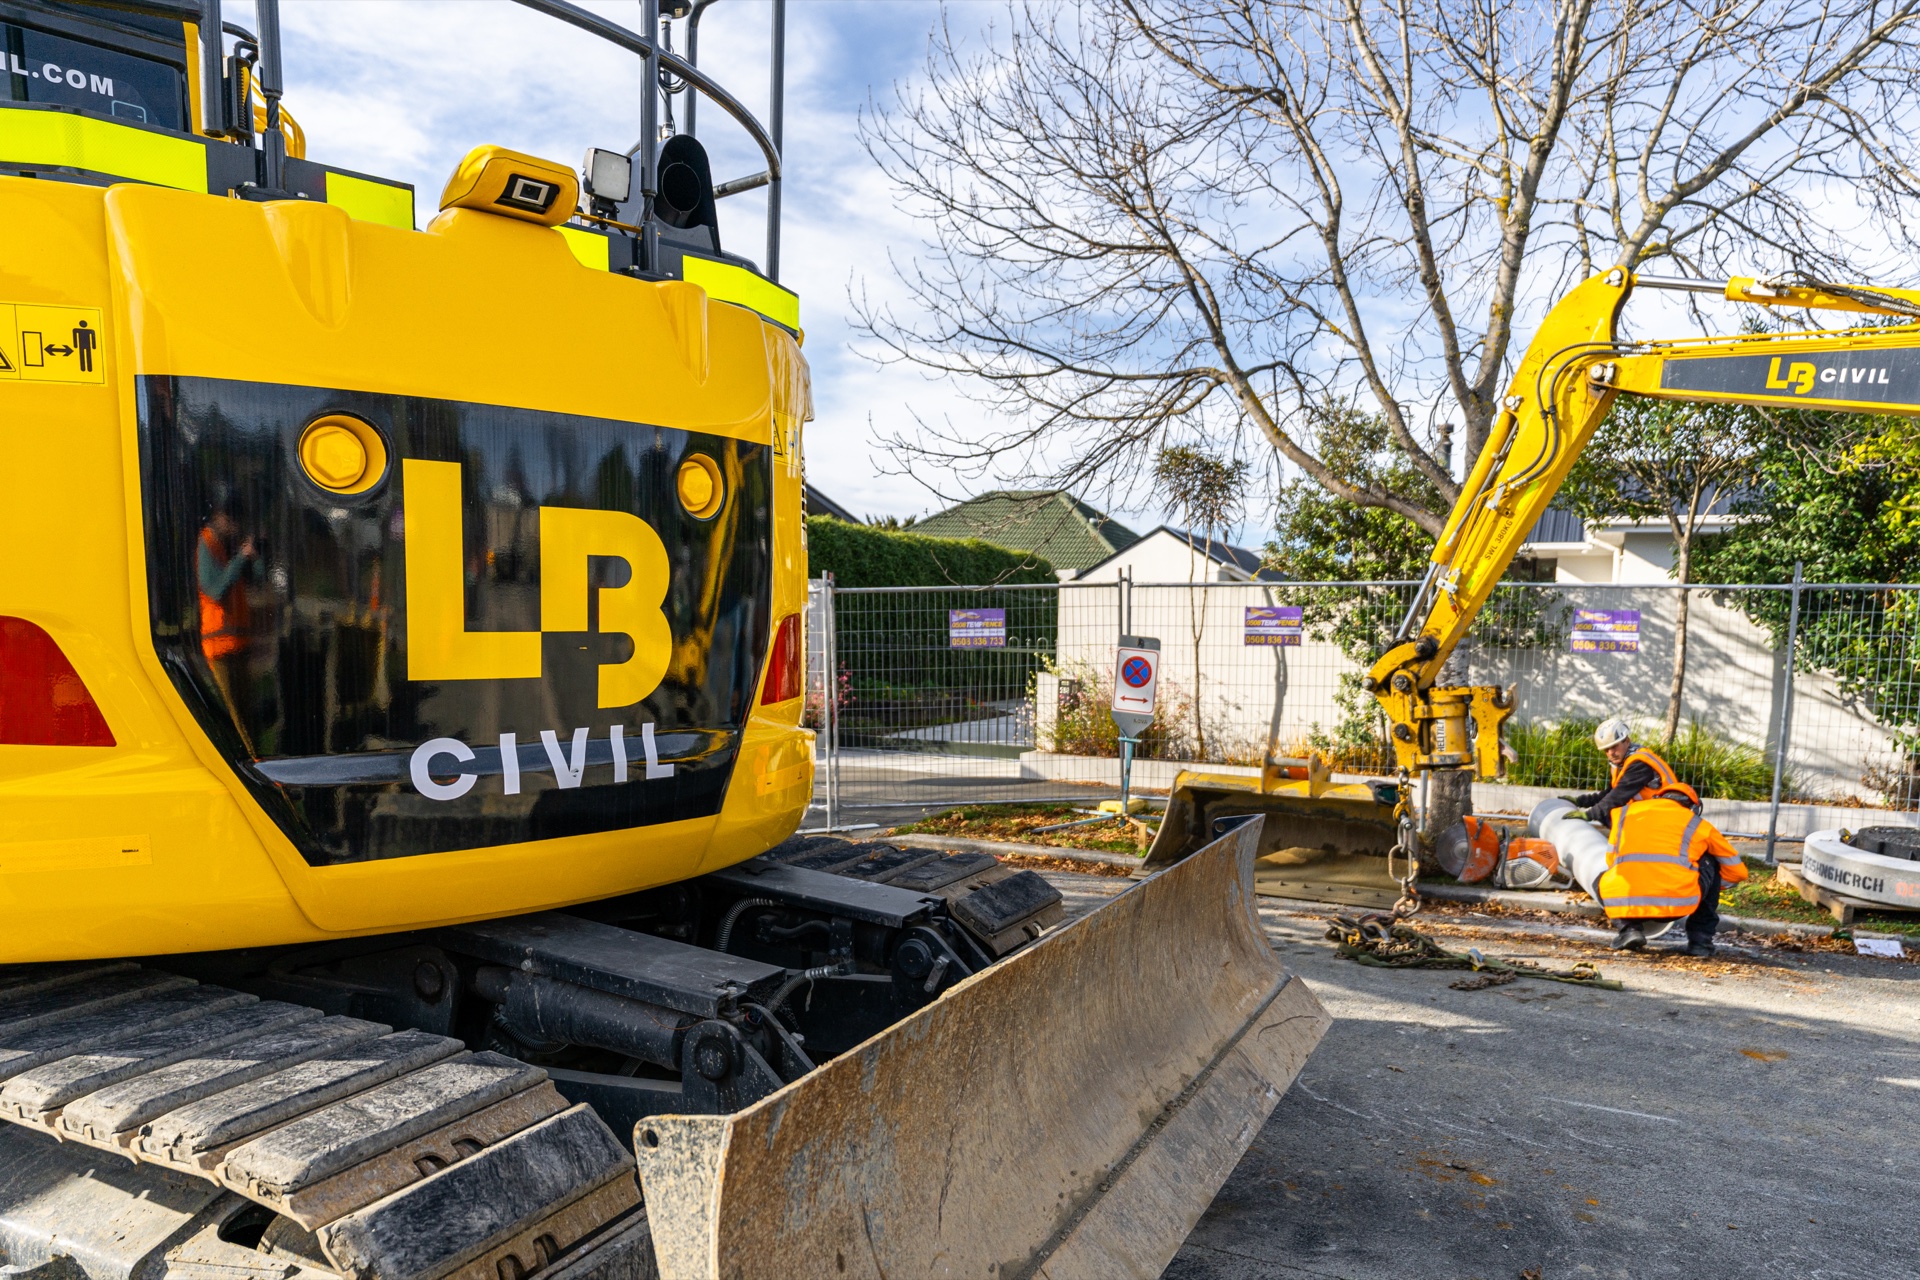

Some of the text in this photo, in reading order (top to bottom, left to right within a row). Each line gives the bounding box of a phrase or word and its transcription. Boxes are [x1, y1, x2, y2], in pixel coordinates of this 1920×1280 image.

[1765, 356, 1890, 395] LB CIVIL
[1485, 519, 1513, 560] SWL 380KG
[402, 458, 673, 708] LB
[990, 637, 1003, 645] 733
[1246, 635, 1299, 644] 0508 836 733
[1573, 640, 1637, 651] 0508 836 733
[409, 722, 675, 801] CIVIL
